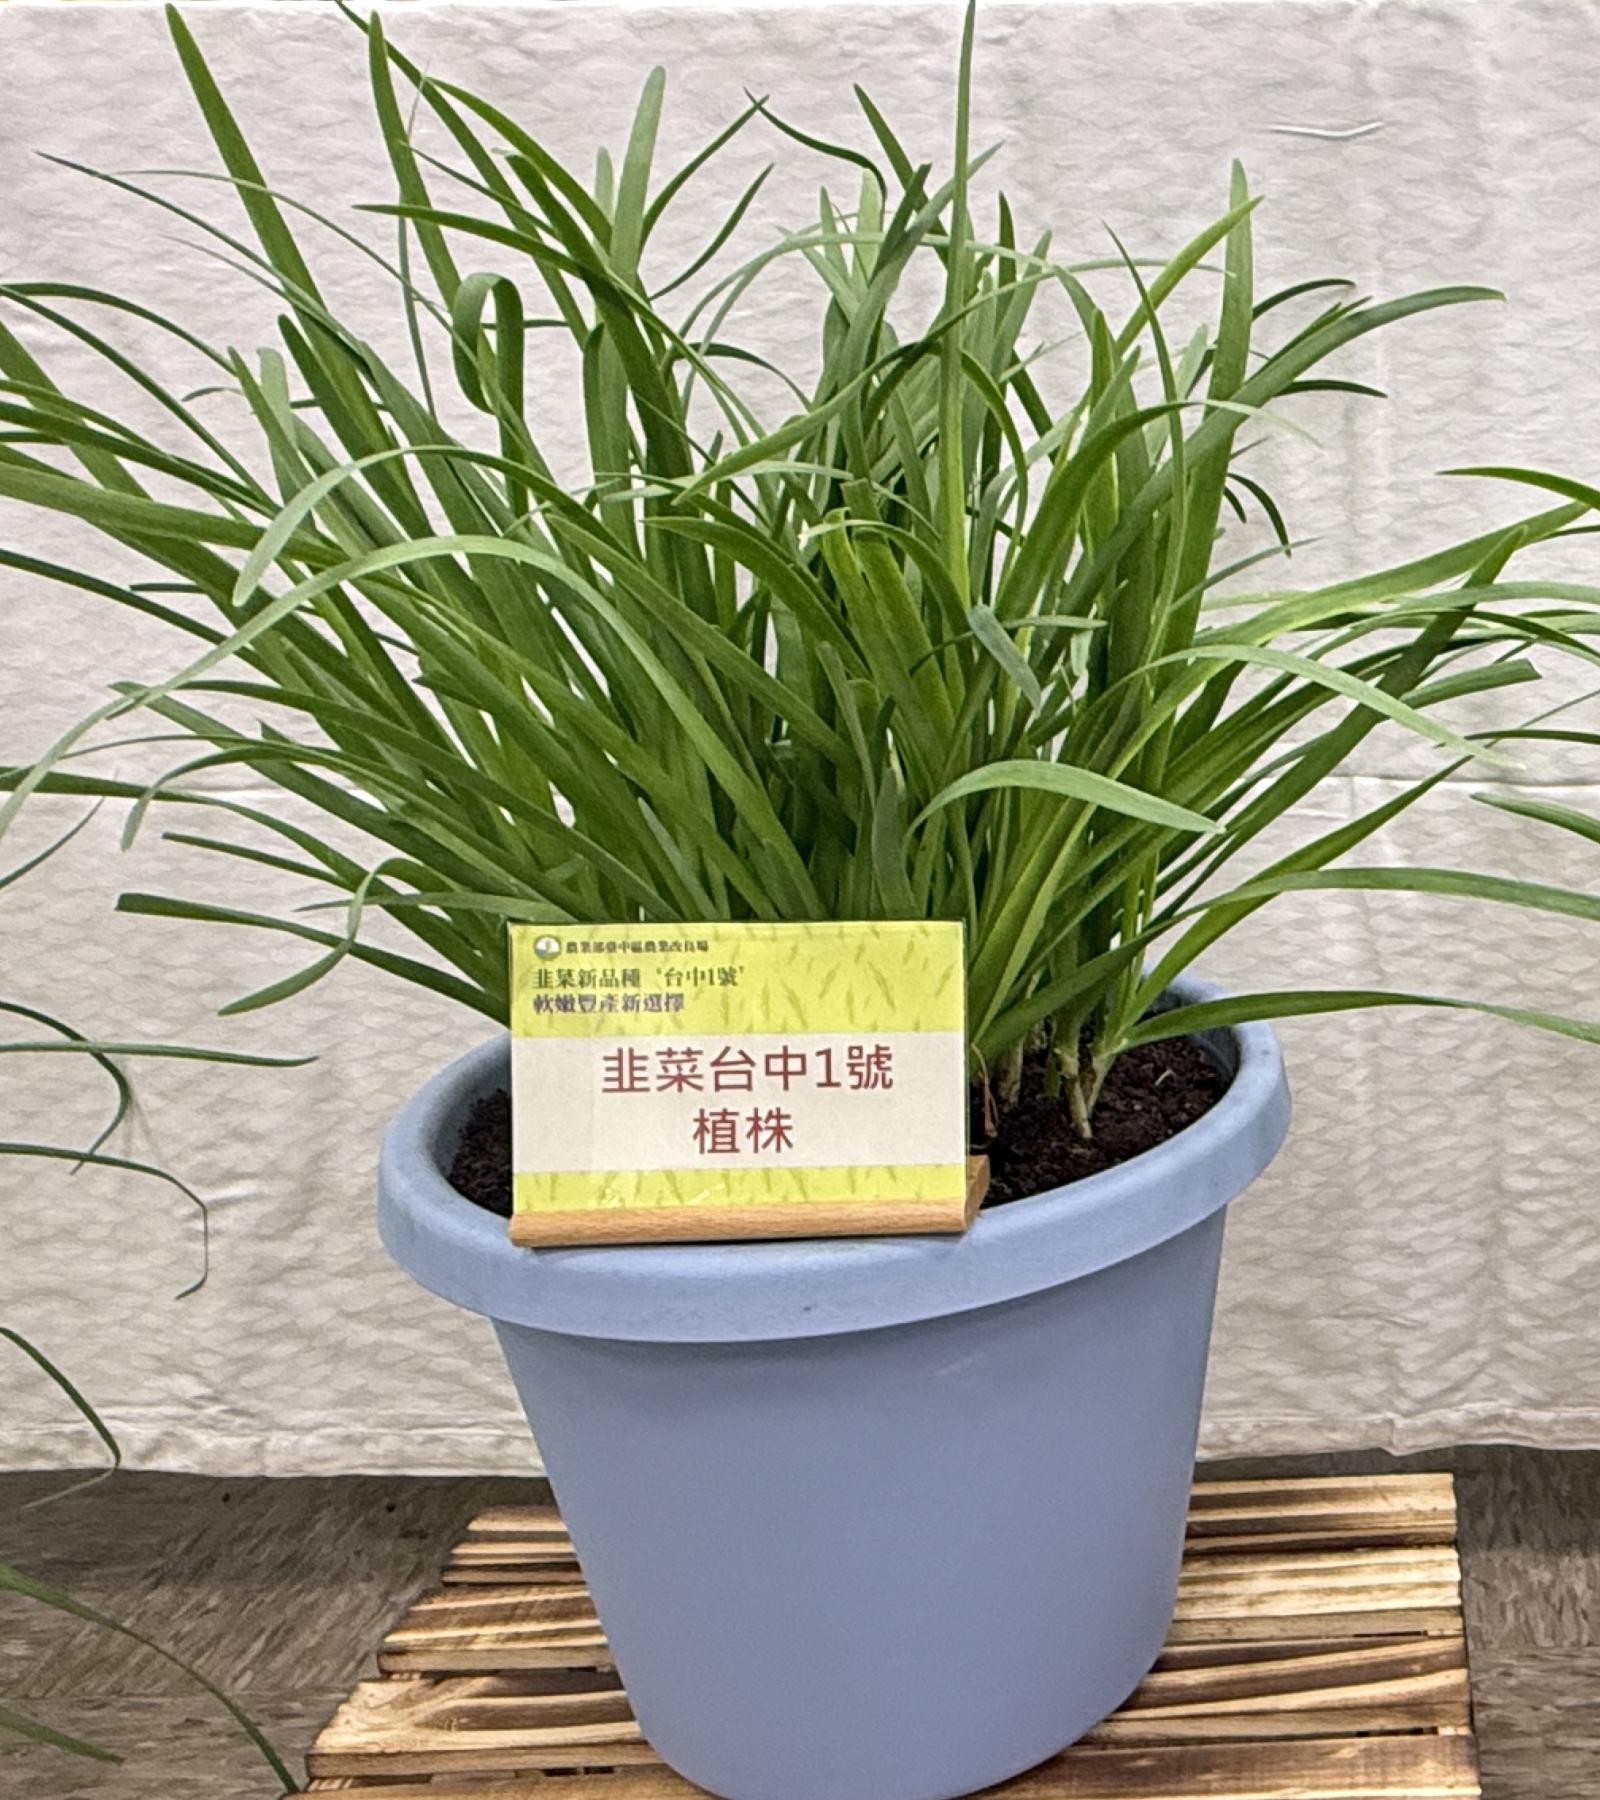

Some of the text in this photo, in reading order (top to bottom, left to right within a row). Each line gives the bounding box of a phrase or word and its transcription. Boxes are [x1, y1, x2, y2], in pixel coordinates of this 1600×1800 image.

[602, 1043, 894, 1094] 韭菜台中1號
[692, 1106, 794, 1155] 植株
